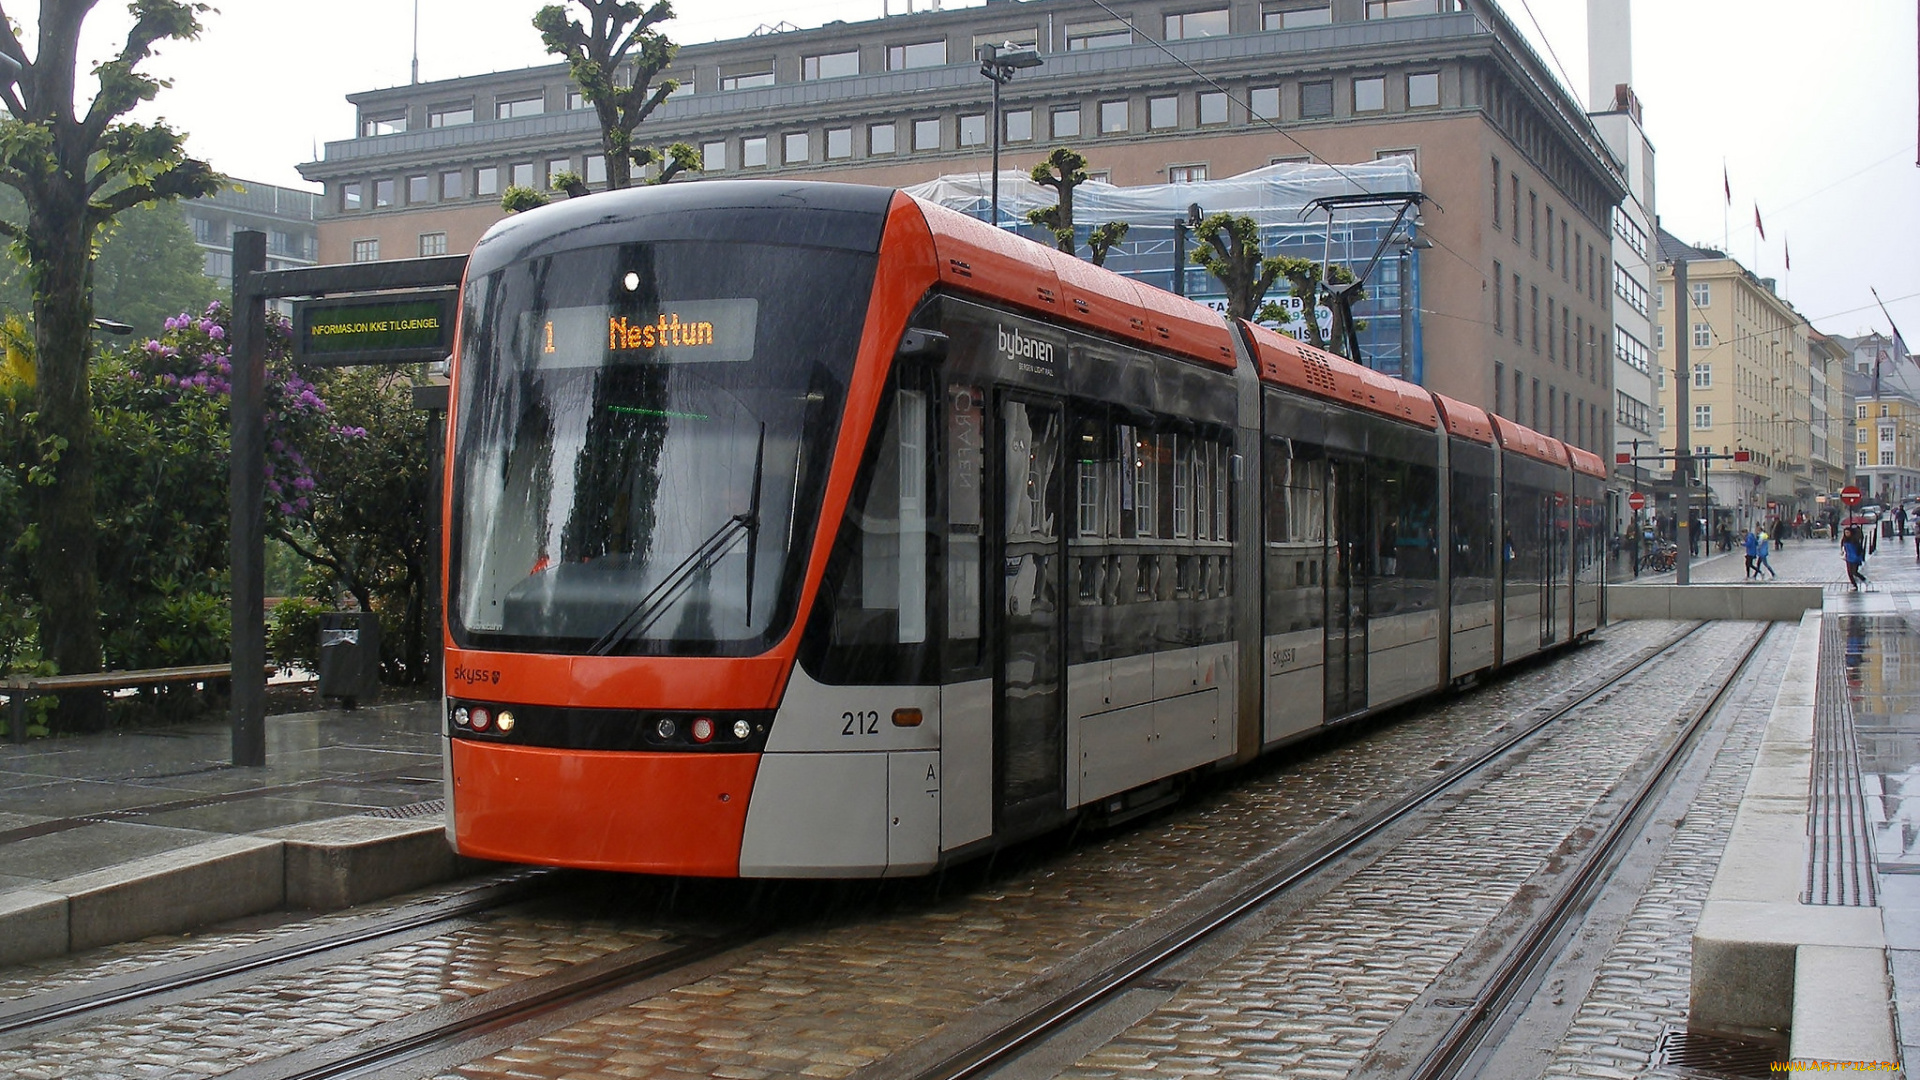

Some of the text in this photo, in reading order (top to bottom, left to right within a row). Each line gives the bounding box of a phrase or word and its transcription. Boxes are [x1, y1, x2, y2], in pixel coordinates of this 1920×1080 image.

[311, 318, 439, 335] INFORMASJON IKKE TILGJENGEL
[543, 313, 713, 353] 1 Nesttun
[998, 323, 1054, 363] bybanen
[1272, 647, 1291, 668] skyss
[454, 664, 489, 684] skyss
[841, 711, 879, 736] 212
[926, 763, 936, 780] A
